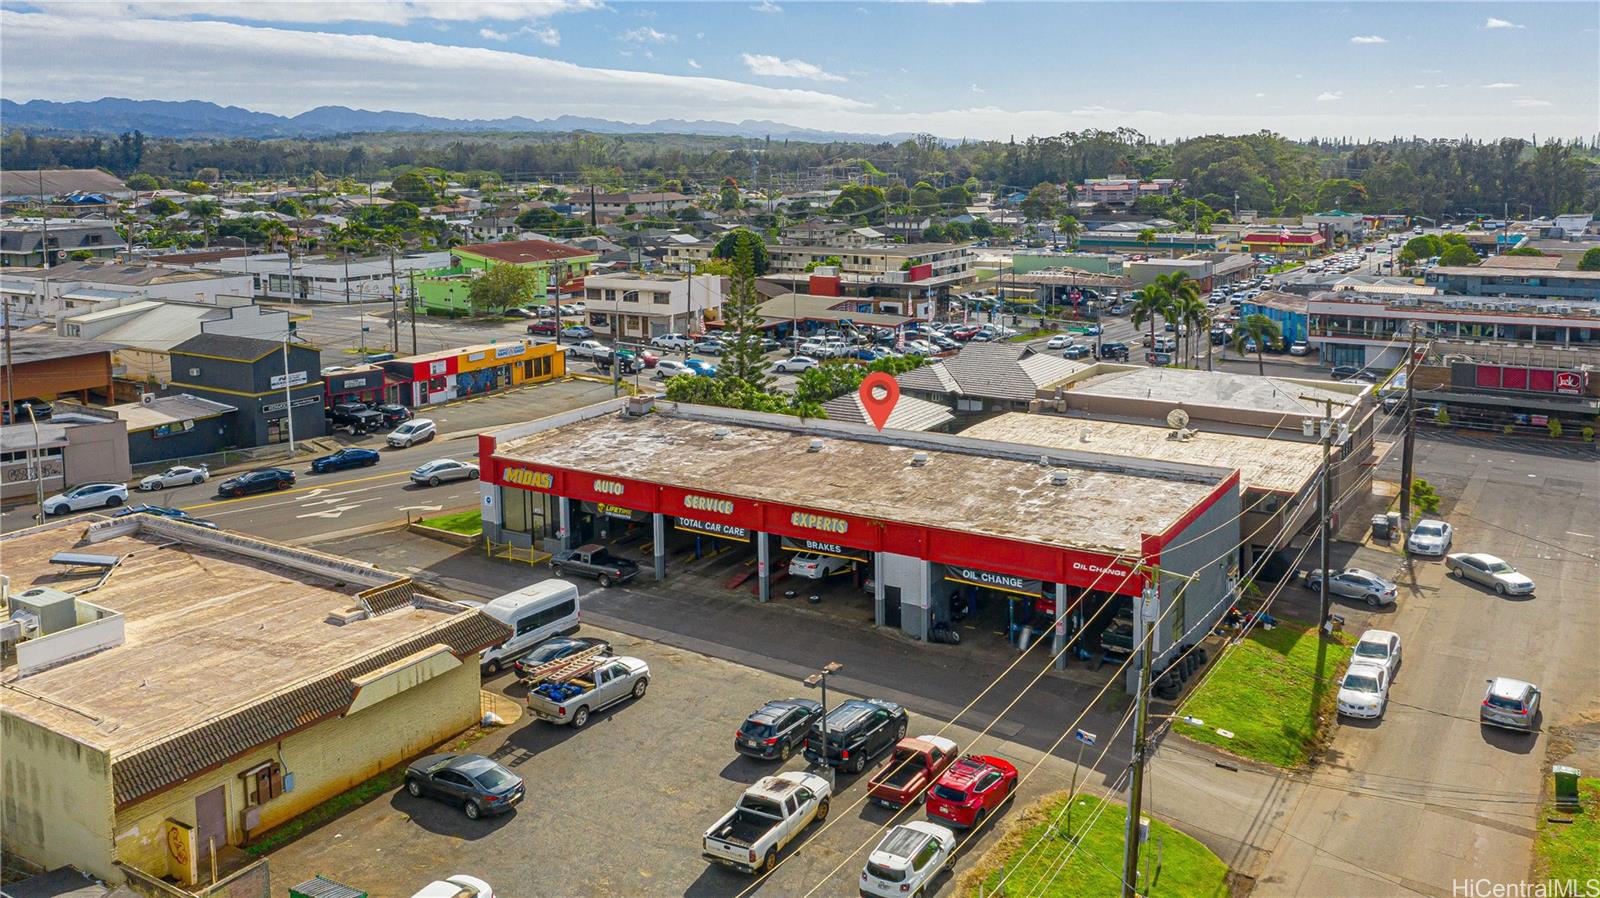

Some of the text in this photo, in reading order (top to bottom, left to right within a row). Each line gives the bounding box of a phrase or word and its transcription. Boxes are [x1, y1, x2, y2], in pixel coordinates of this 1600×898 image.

[503, 466, 553, 489] MIDAS
[594, 480, 848, 534] AUTO SERVICE EXPERTS
[680, 517, 745, 537] TOTAL CAR CARE
[806, 541, 841, 553] BRAKES
[962, 569, 1023, 588] OIL CHANGE
[1073, 562, 1127, 577] OIL CHANGE
